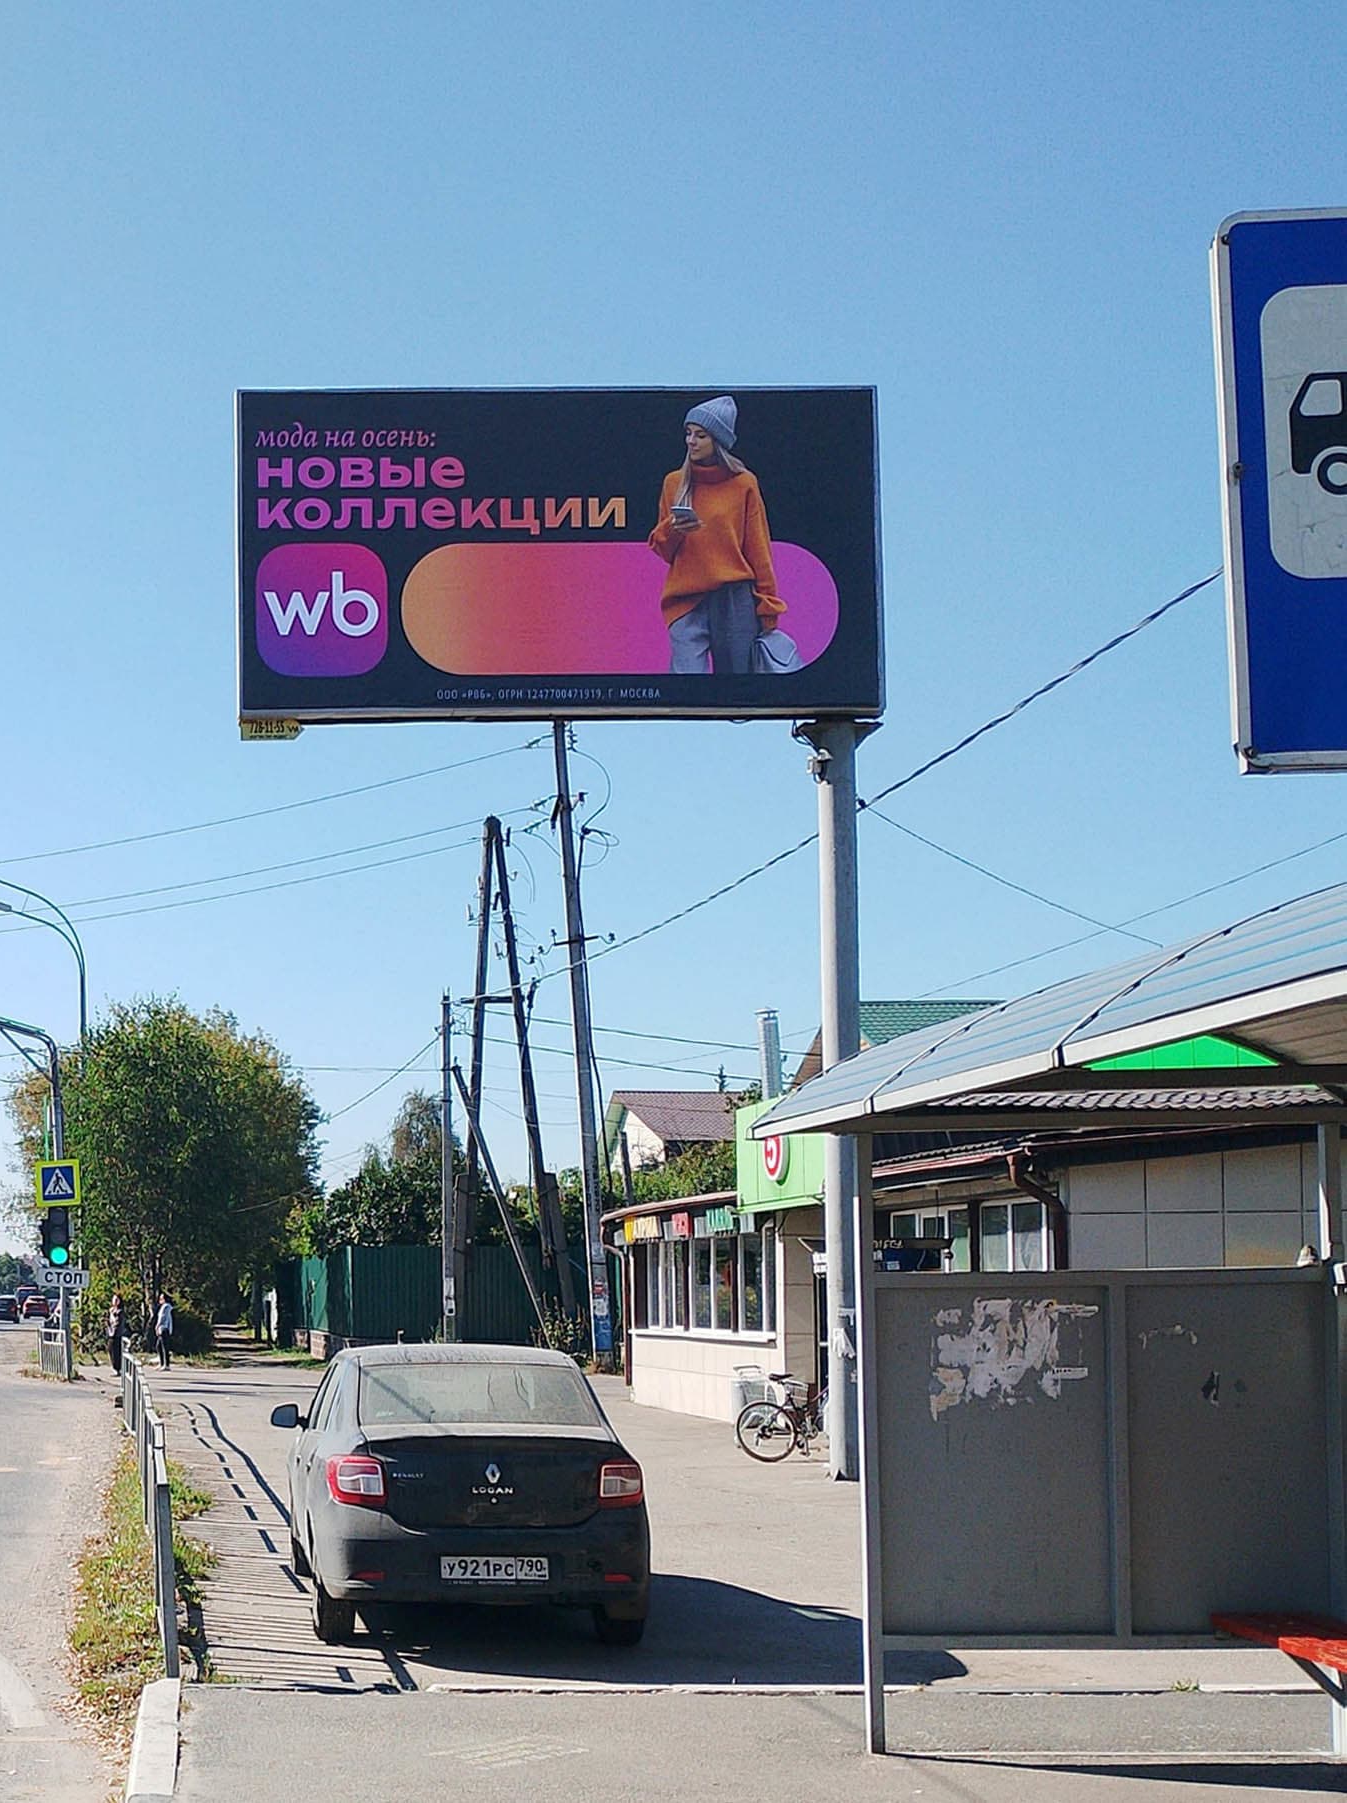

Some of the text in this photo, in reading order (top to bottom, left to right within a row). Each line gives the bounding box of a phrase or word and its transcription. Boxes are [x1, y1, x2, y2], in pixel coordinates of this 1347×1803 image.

[255, 421, 437, 449] мода на осень:
[256, 455, 466, 489] новые
[256, 497, 627, 535] коллекции
[263, 570, 380, 637] wb
[436, 688, 458, 700] ООО
[497, 688, 523, 700] ОГРН
[619, 687, 661, 699] МОСКВА
[44, 1271, 83, 1285] СТОП
[472, 1486, 514, 1495] LOGAN
[446, 1559, 544, 1578] У921РС 790
